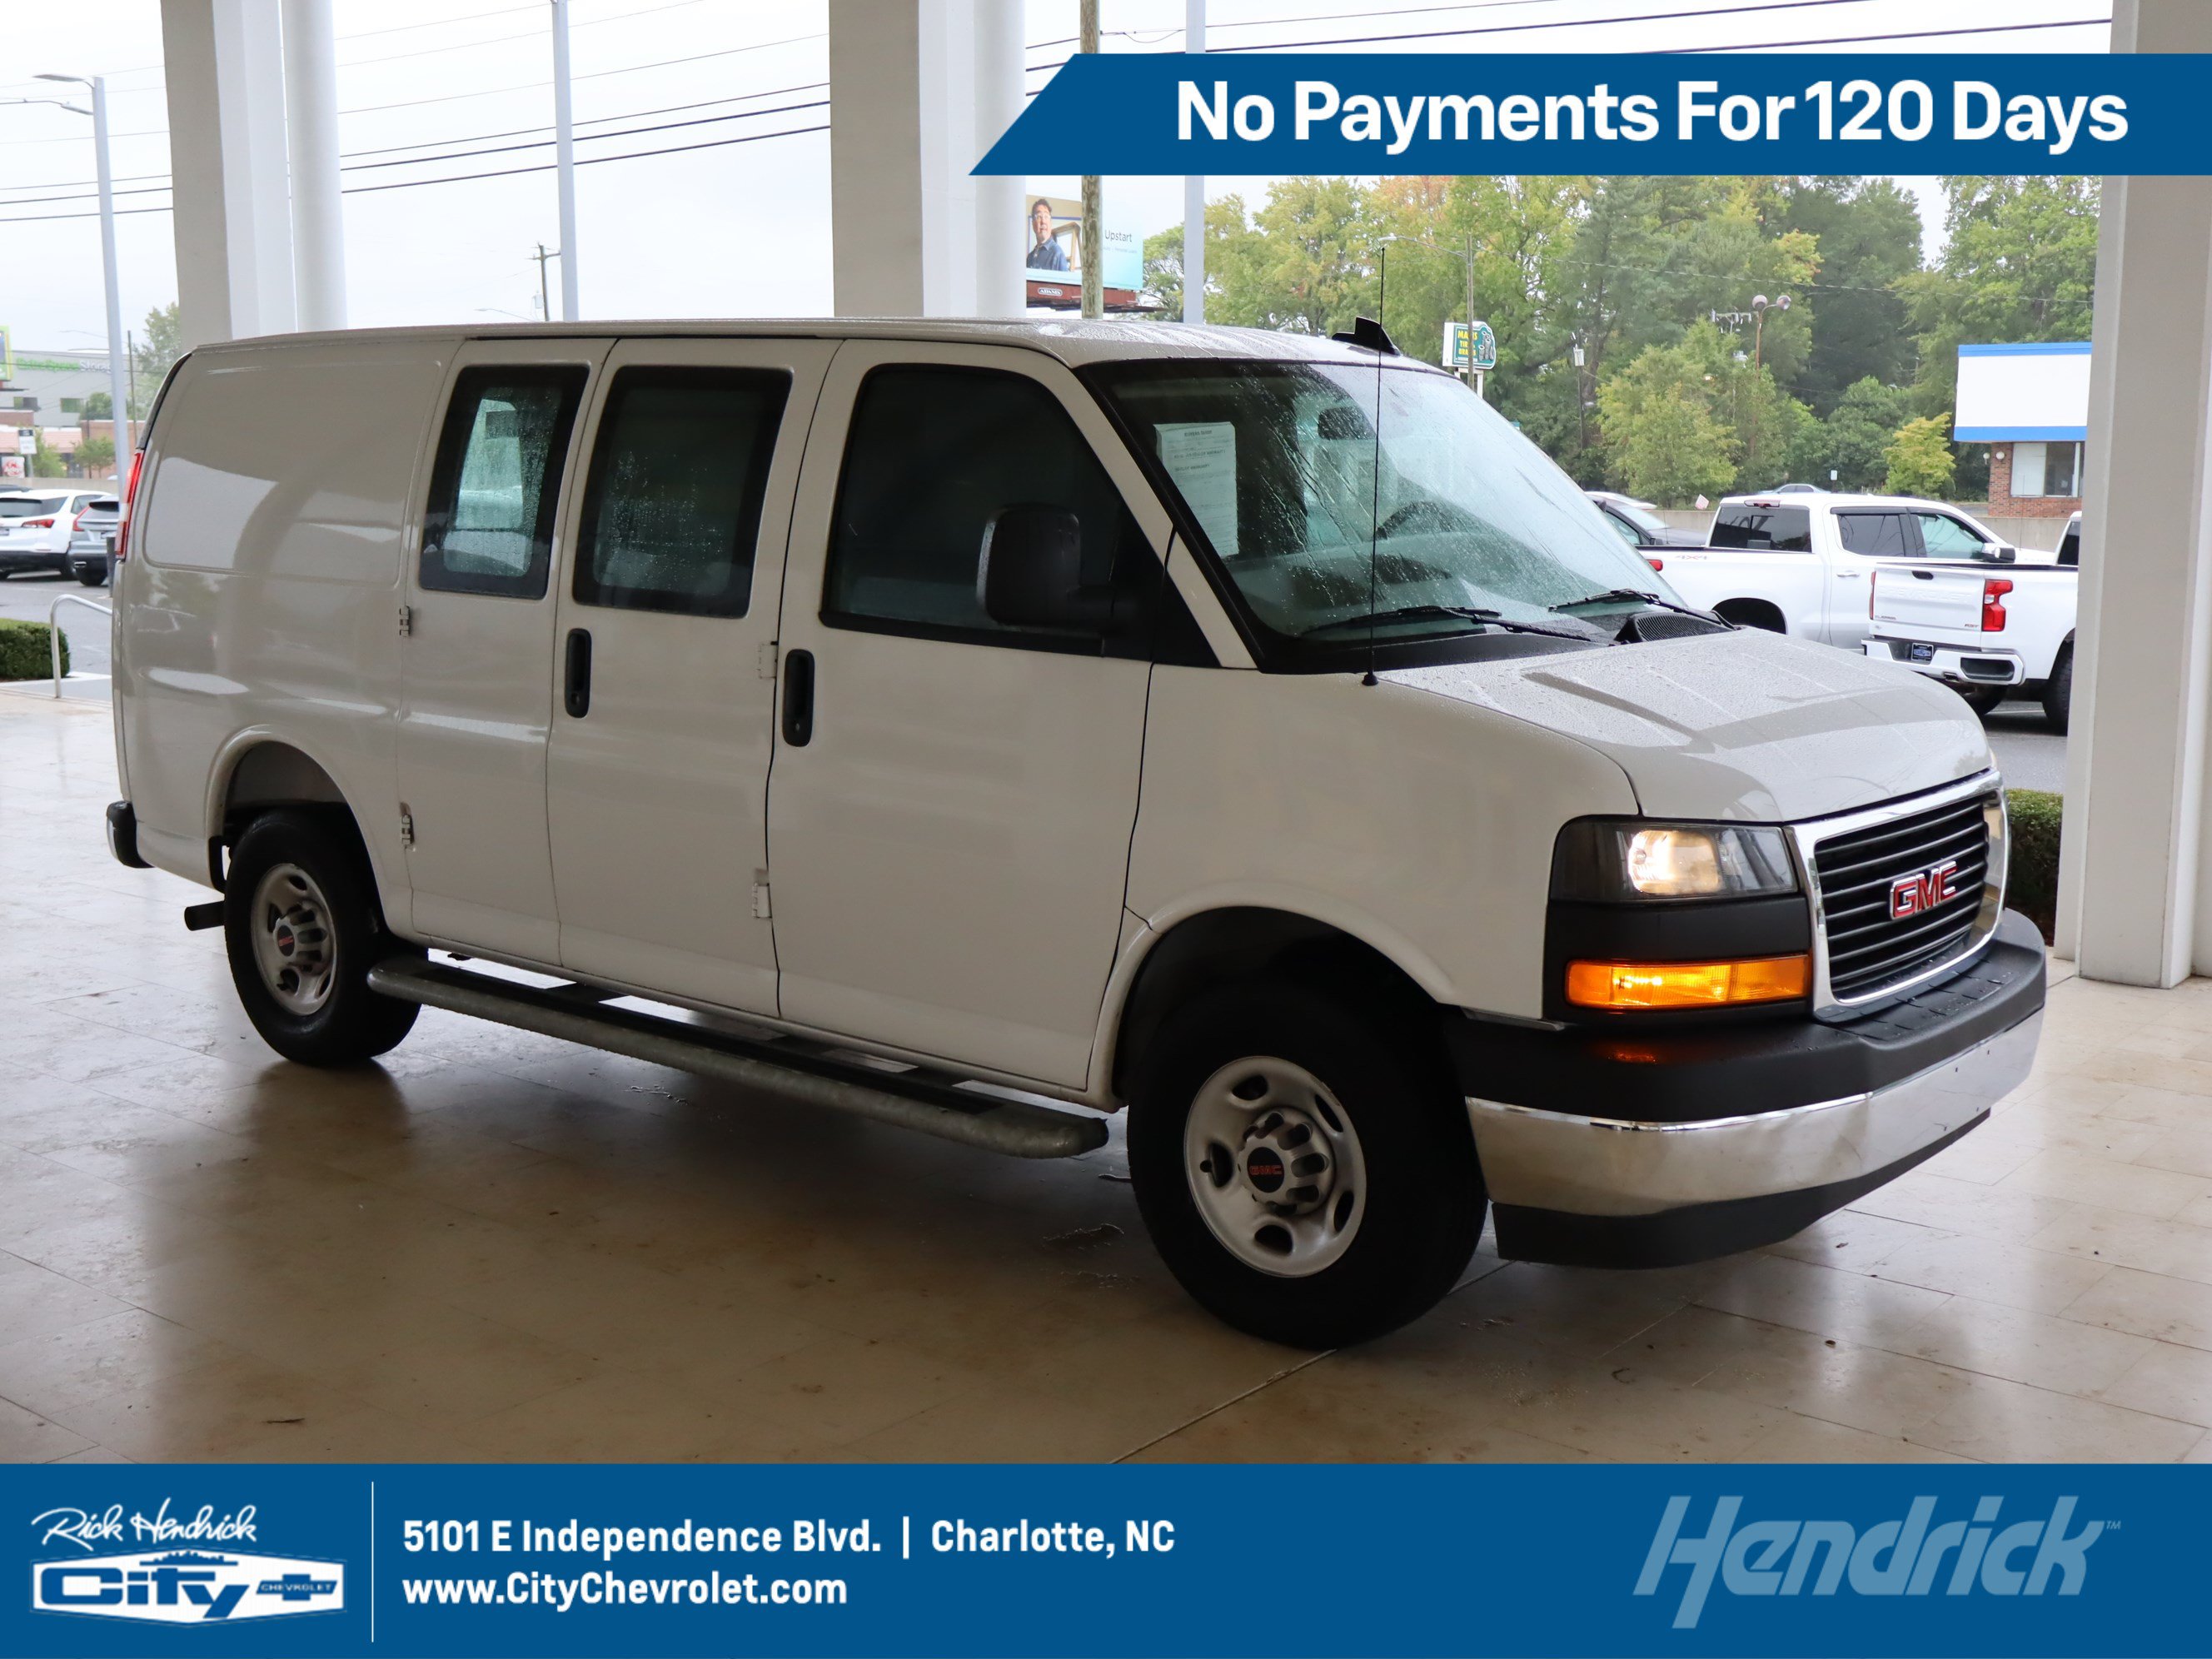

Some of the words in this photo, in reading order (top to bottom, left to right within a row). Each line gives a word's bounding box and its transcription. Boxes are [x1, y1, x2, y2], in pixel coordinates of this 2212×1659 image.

[1104, 230, 1133, 242] Upstart
[1890, 860, 1957, 920] GMC
[1251, 1165, 1283, 1176] GMC
